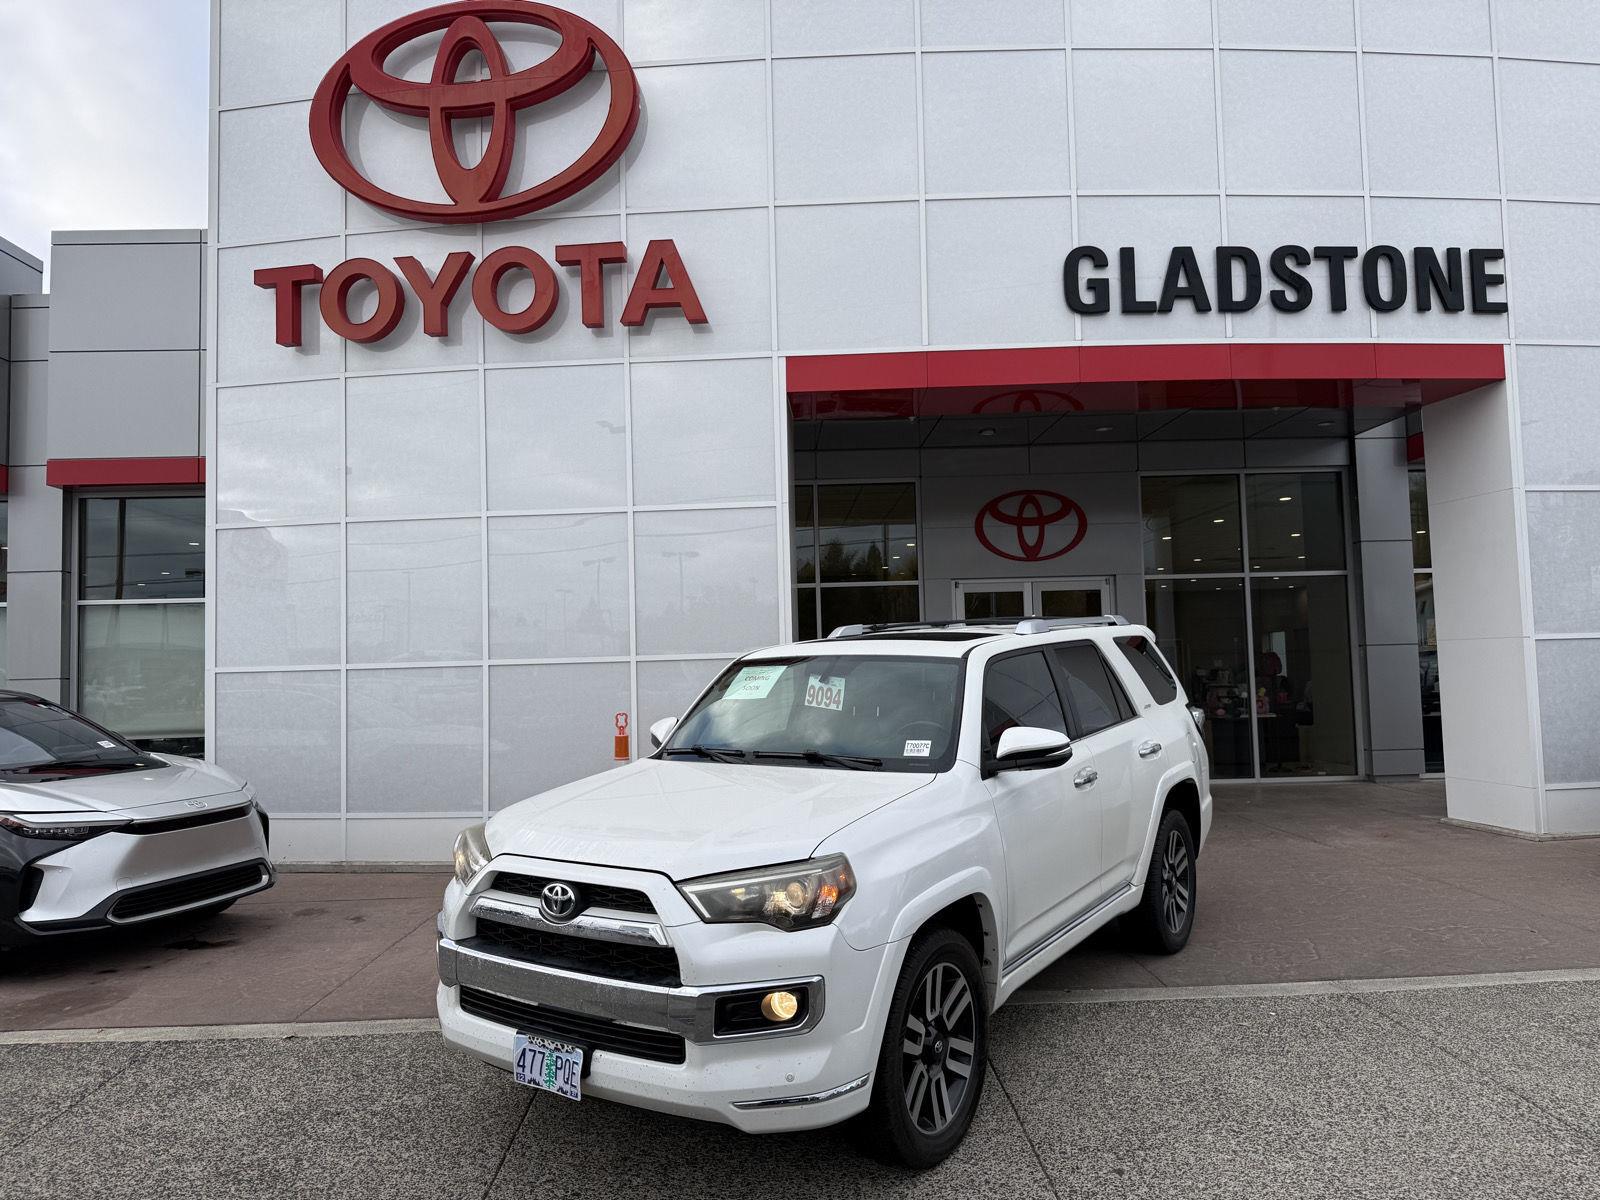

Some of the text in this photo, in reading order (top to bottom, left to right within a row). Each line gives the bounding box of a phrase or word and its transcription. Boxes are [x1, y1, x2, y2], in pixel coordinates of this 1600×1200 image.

[254, 239, 708, 347] TOYOTA
[1063, 245, 1508, 314] GLADSTONE
[806, 684, 842, 709] 9094
[517, 1048, 579, 1088] 477 PQE
